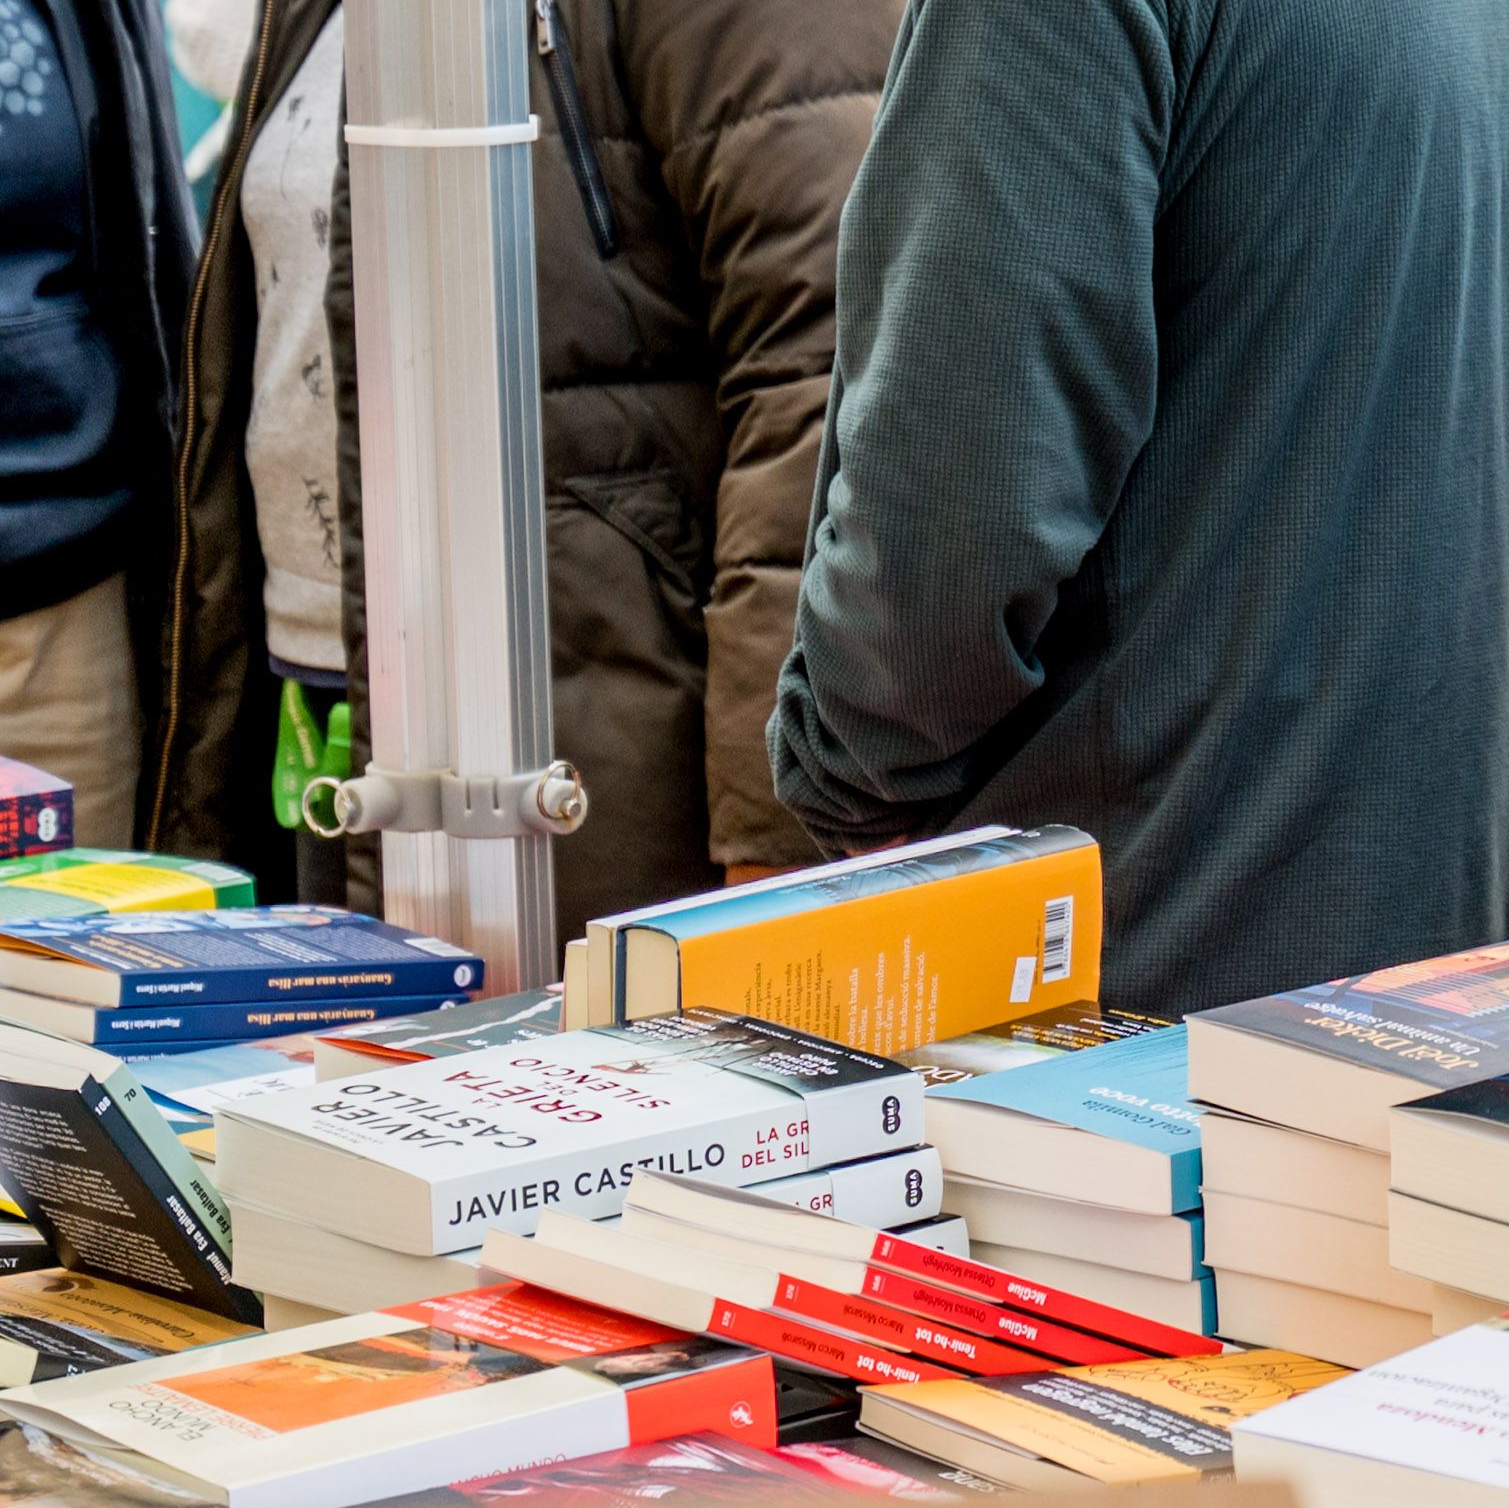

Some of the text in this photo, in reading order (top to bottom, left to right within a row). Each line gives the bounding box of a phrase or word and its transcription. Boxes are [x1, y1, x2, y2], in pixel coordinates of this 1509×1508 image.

[316, 975, 337, 986] una
[337, 973, 392, 988] Guanyaràs
[296, 1011, 317, 1021] una
[318, 1007, 376, 1023] Guanyaràs
[1305, 1014, 1479, 1071] Joël Dicker
[1382, 1020, 1452, 1050] animal
[1452, 1038, 1481, 1056] Un
[442, 1070, 603, 1123] GRIETA
[510, 1058, 672, 1110] SILENCIO
[1089, 1086, 1151, 1109] voce
[311, 1100, 464, 1149] JAVIER
[340, 1084, 537, 1149] CASTILLO
[886, 1098, 898, 1132] SUMA
[757, 1127, 779, 1145] LA
[742, 1146, 776, 1170] DEL
[448, 1179, 561, 1226] JAVIER
[909, 1172, 922, 1206] SUMA
[190, 1179, 231, 1235] Eva Baltasar
[166, 1194, 232, 1285] Mamut Eva Baltasar
[1008, 1281, 1047, 1307] McGlue
[915, 1326, 933, 1342] tot
[998, 1317, 1038, 1341] McGlue
[934, 1331, 977, 1359] Tenir-ho
[856, 1354, 875, 1370] tot
[141, 1399, 205, 1437] MUNDO
[1376, 1402, 1491, 1435] Mendoza
